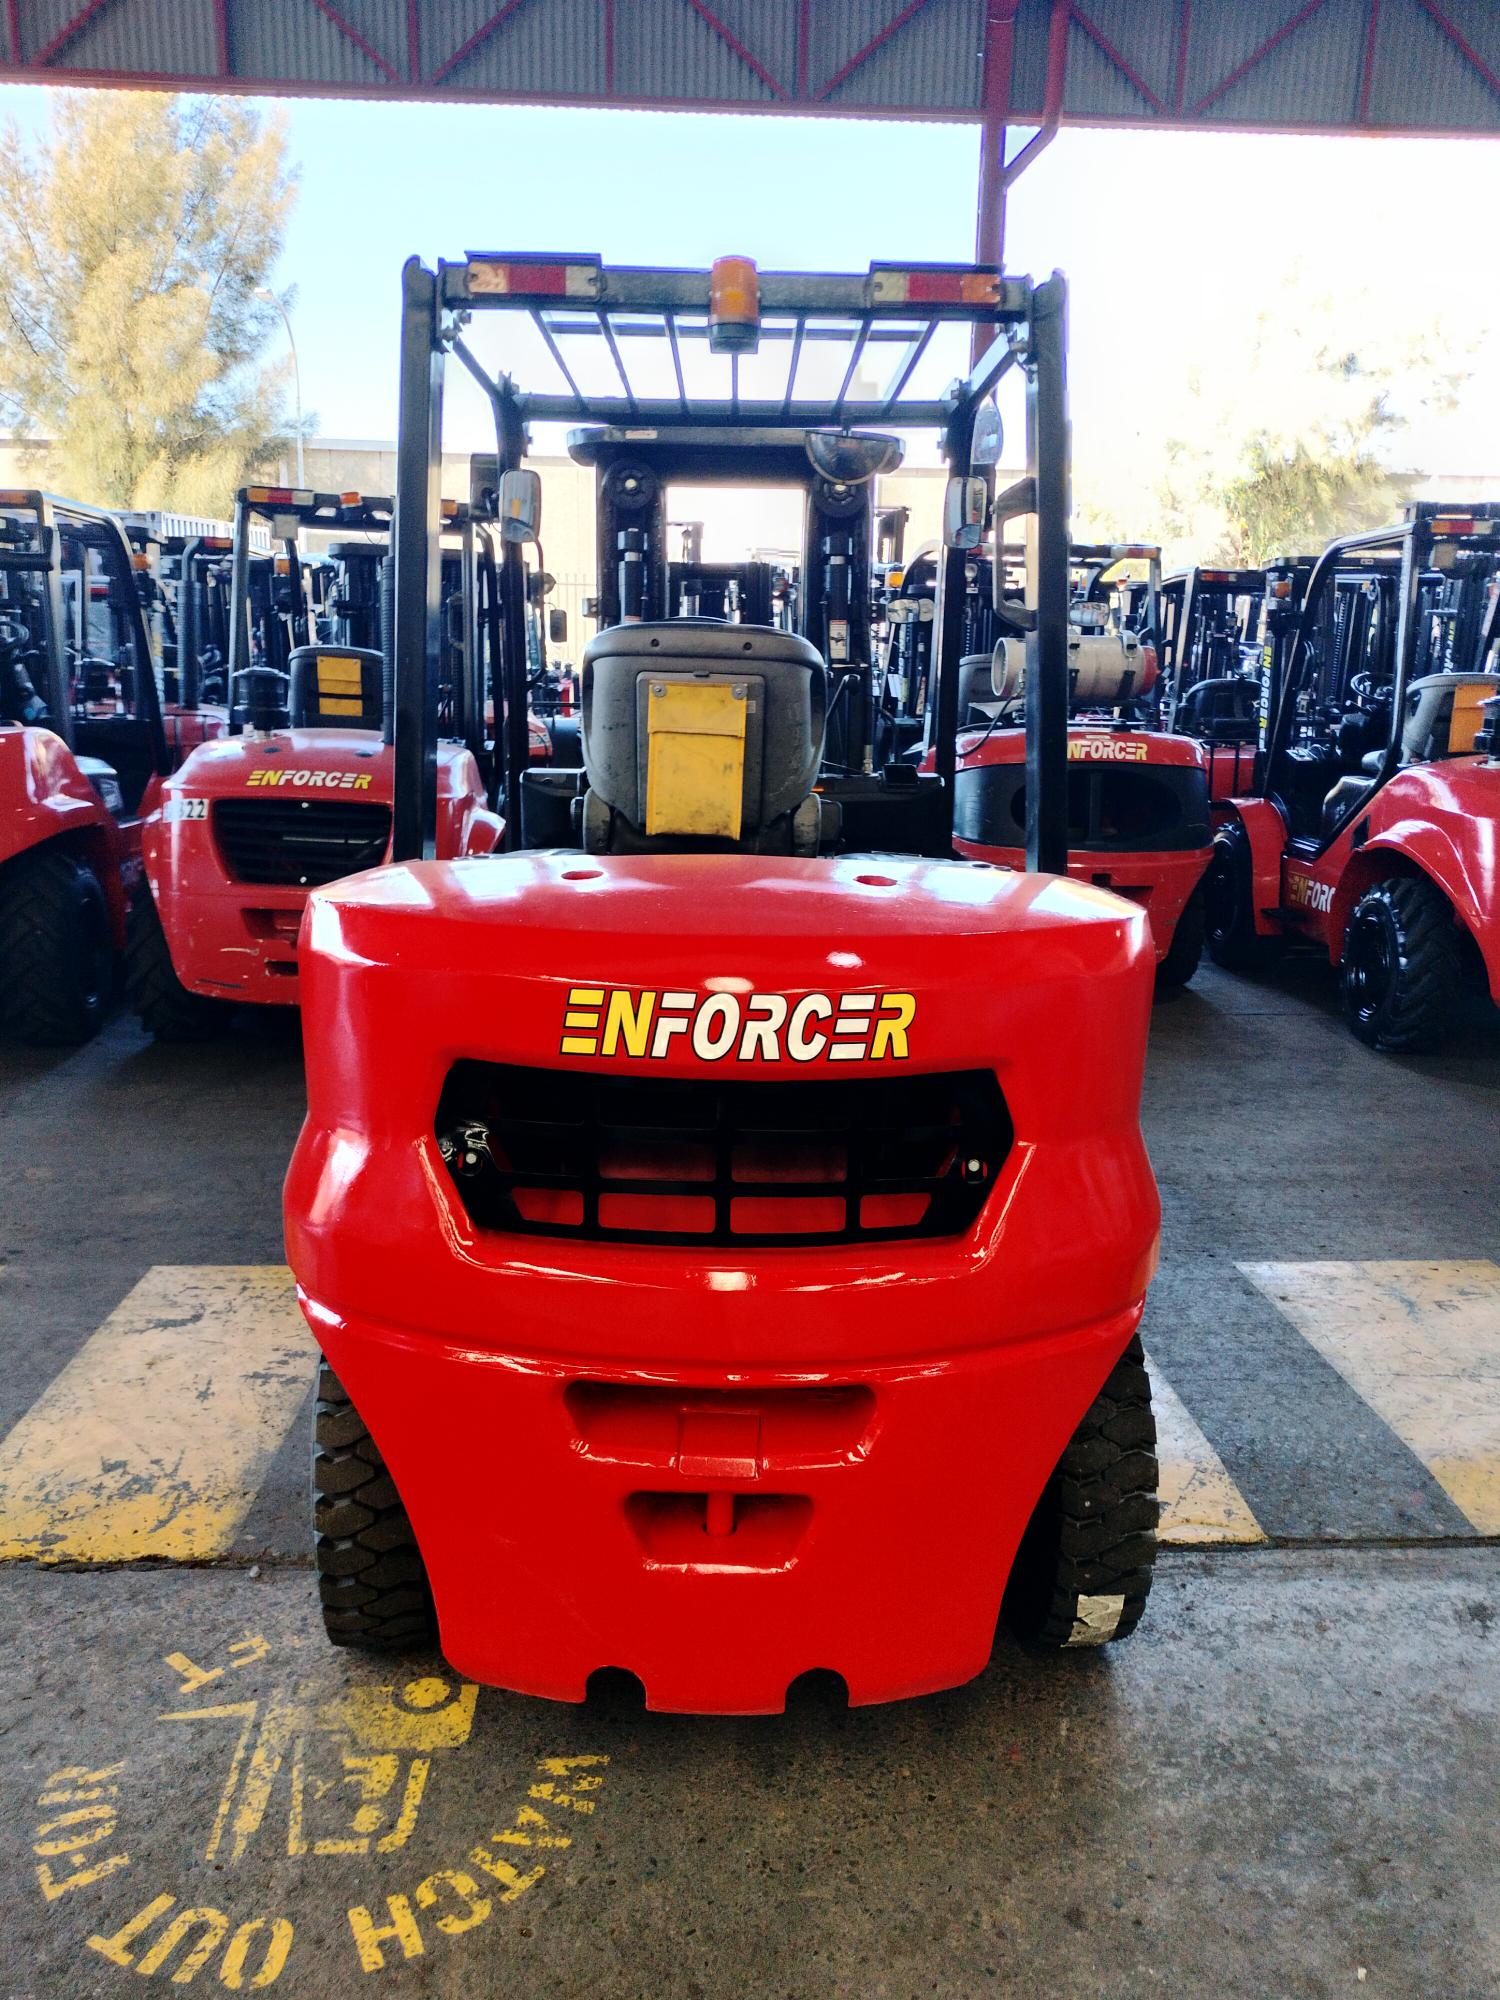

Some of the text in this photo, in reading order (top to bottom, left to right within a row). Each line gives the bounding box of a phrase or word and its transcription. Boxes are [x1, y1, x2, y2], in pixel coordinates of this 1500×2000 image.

[246, 770, 373, 789] ENFORCER
[559, 987, 917, 1062] ENFORCER
[33, 1754, 610, 1990] WATCH OUT FOR
